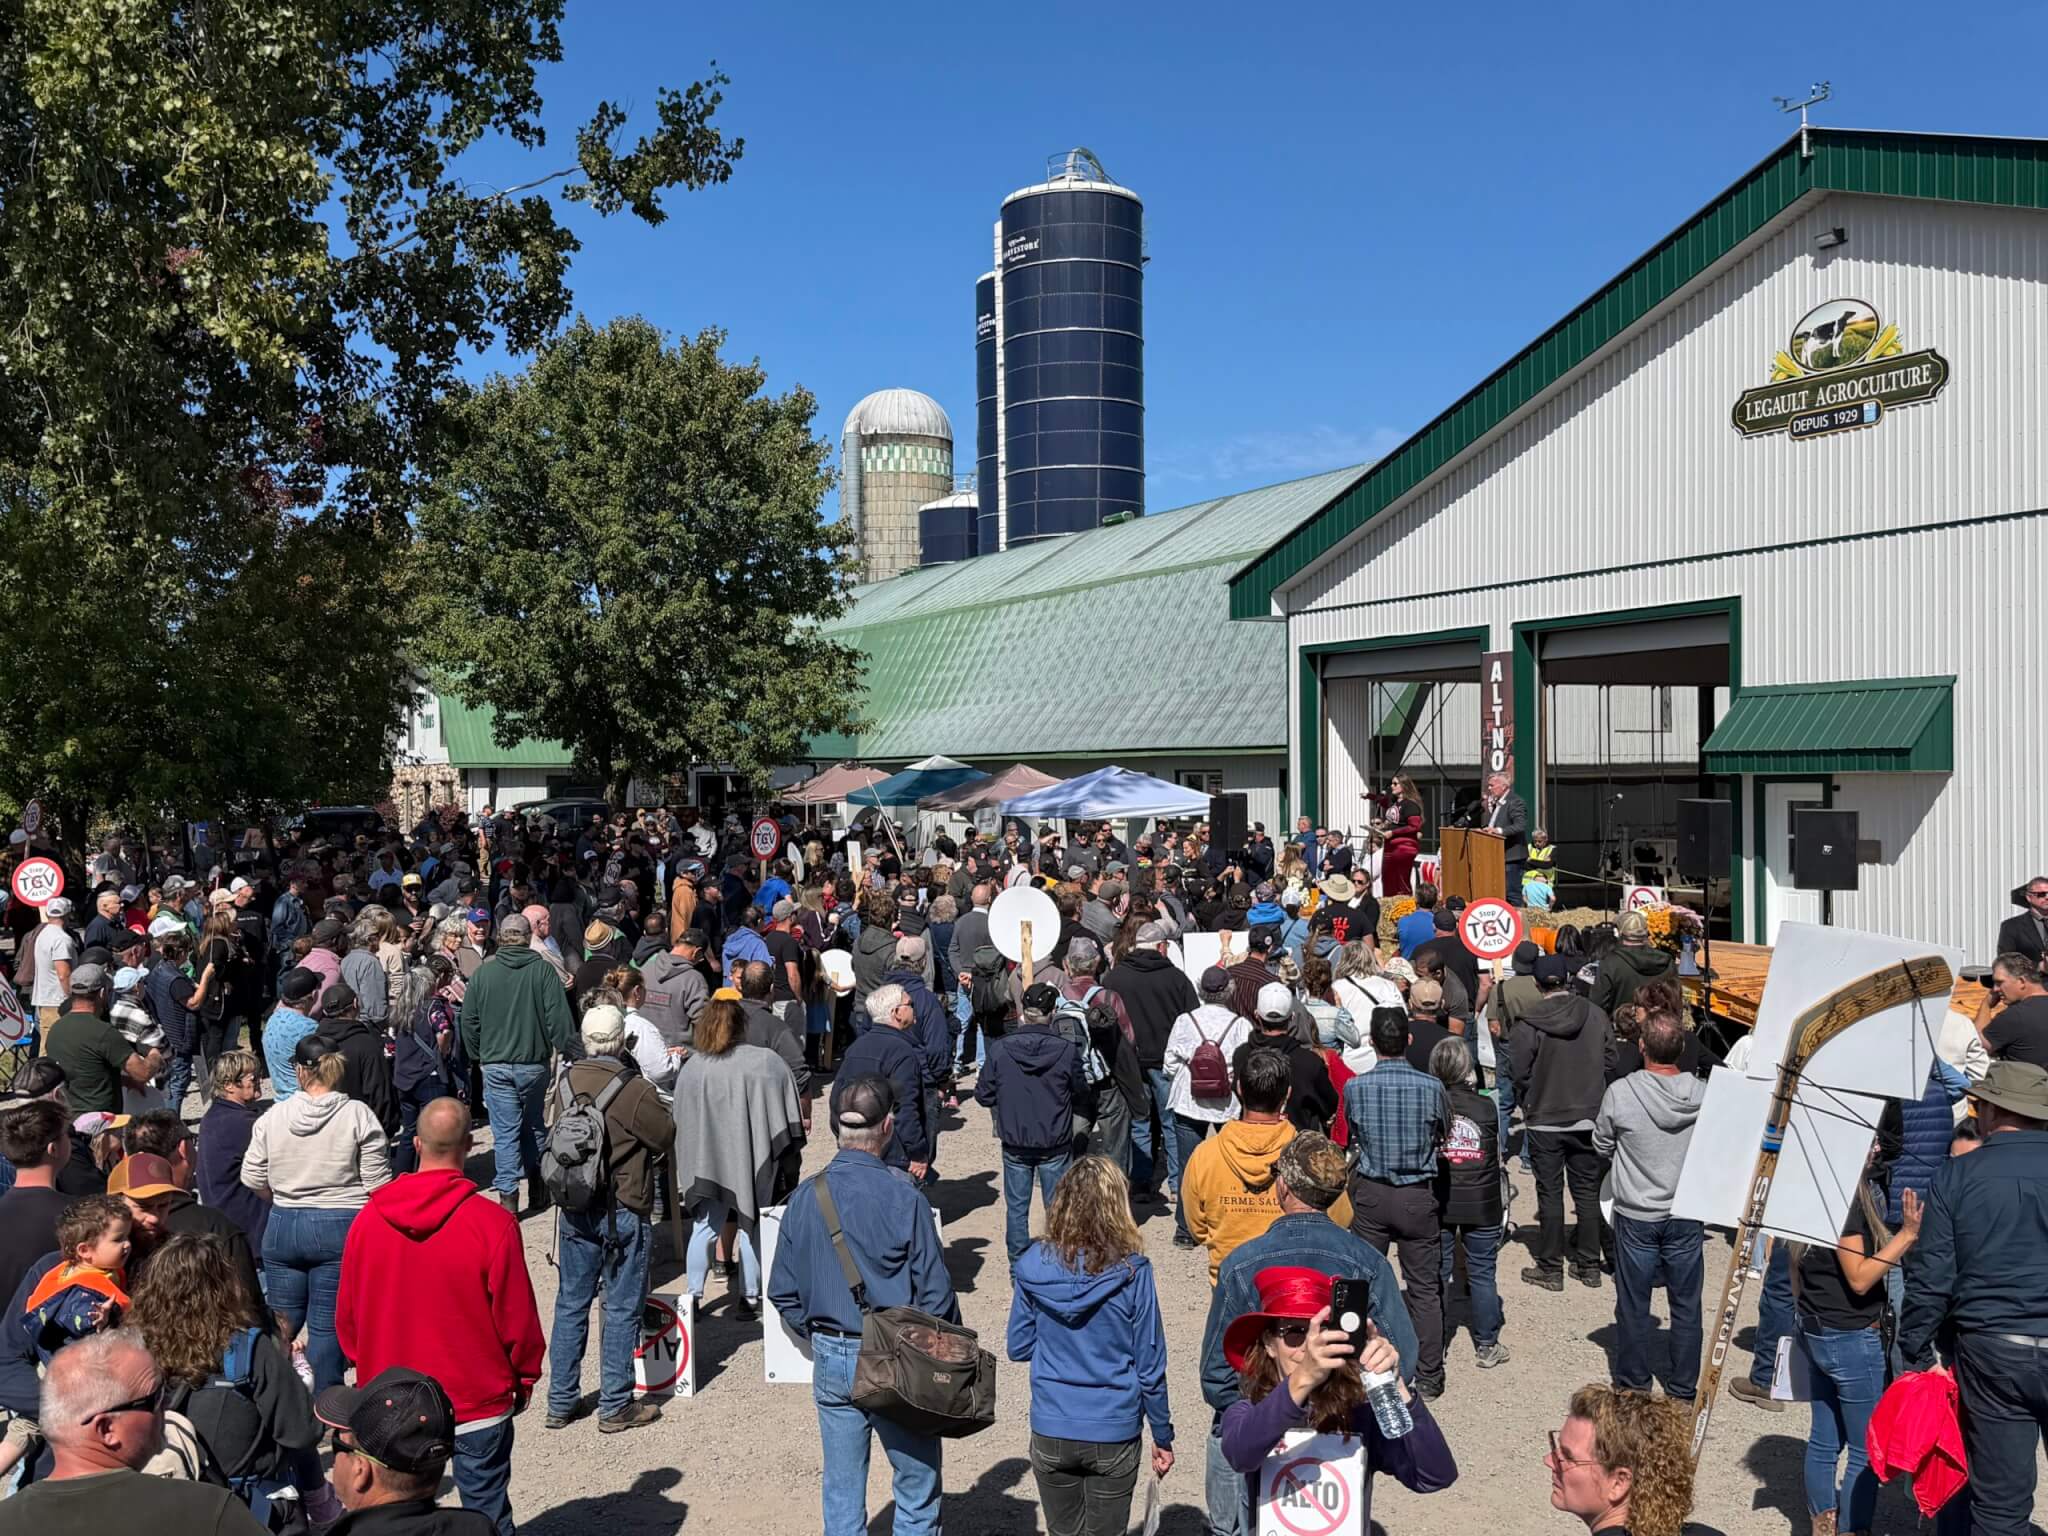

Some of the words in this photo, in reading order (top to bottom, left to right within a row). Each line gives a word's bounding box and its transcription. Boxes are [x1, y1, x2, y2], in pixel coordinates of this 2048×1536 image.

[1745, 390, 1809, 421] LEGAULT
[1815, 363, 1932, 407] AGROCULTURE
[1793, 414, 1829, 433] DEPUIS
[1833, 409, 1858, 425] 1929
[757, 831, 776, 845] TGV
[19, 872, 55, 891] TGV
[1467, 917, 1511, 939] TGV
[1483, 938, 1504, 947] ALTO
[672, 1298, 688, 1317] NON
[675, 1378, 690, 1394] NO
[1281, 1479, 1339, 1511] ALTO
